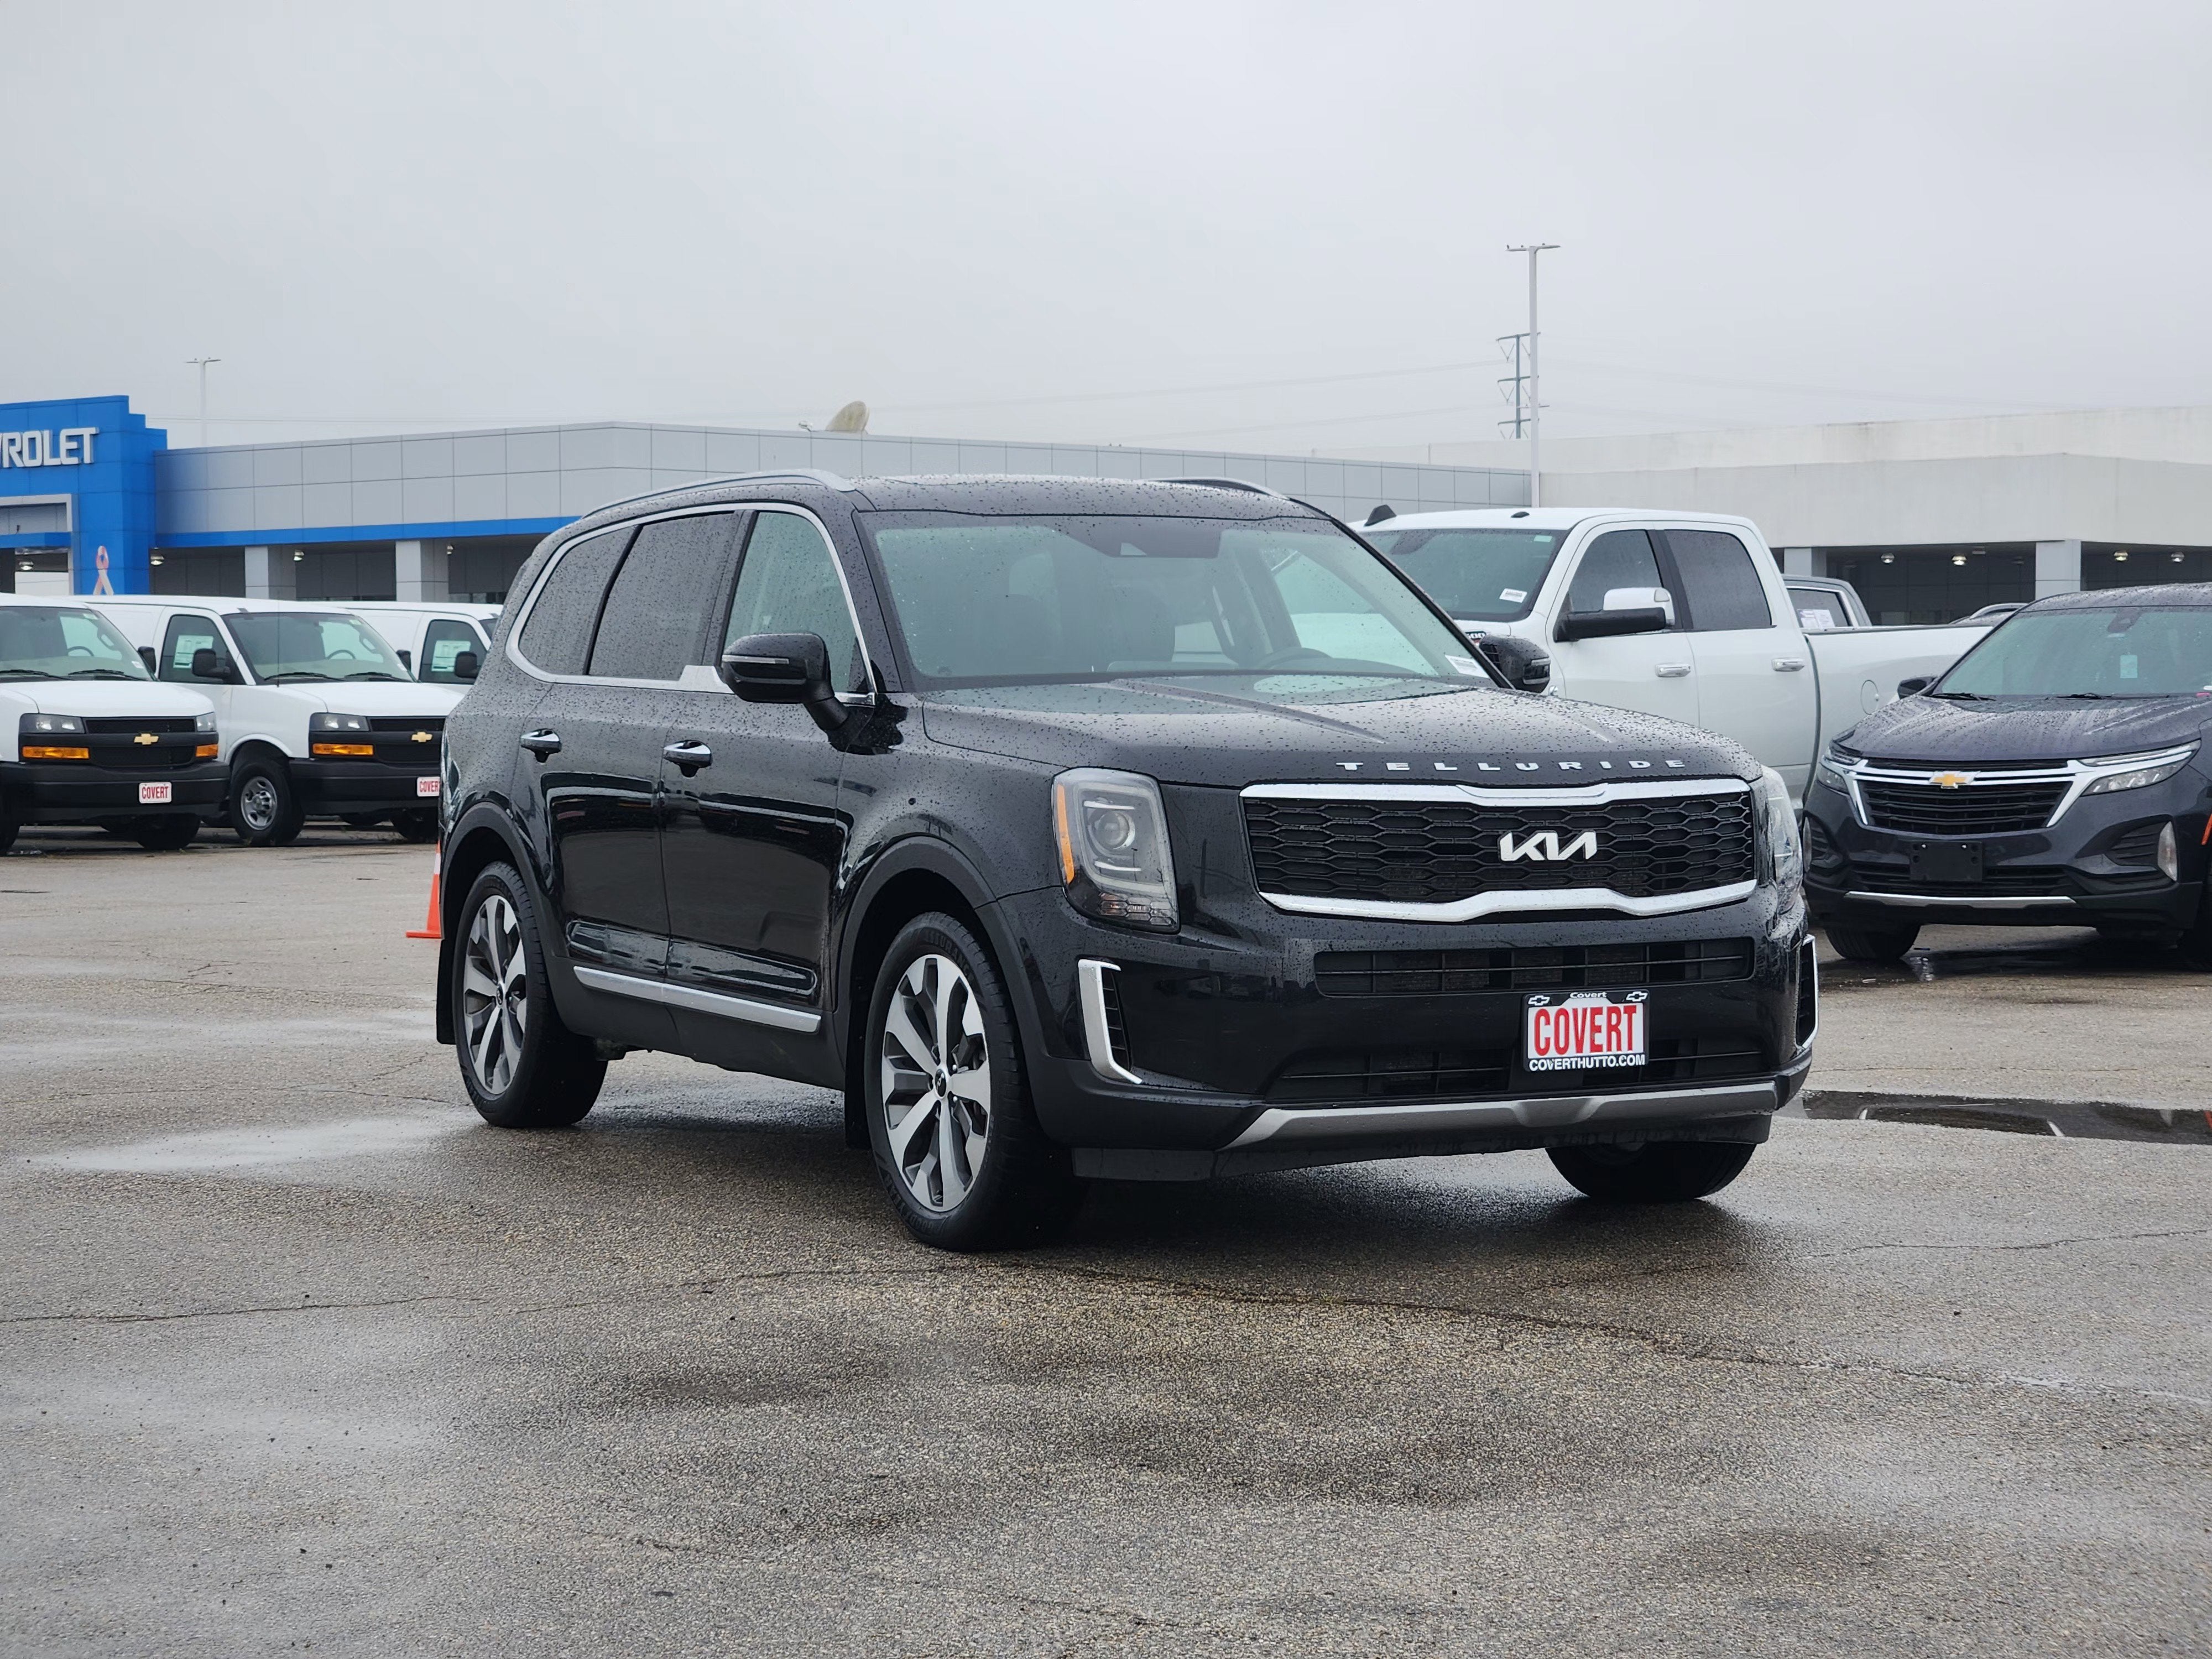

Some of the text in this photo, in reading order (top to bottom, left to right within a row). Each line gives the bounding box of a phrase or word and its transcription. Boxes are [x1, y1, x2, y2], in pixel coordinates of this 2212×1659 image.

[0, 427, 100, 468] ROLET
[1336, 760, 1686, 771] TELLURIDE
[142, 786, 169, 800] COVERT
[419, 780, 439, 792] COVER
[1499, 830, 1597, 862] KIA
[1569, 991, 1607, 999] Covert
[1533, 1005, 1637, 1056] COVERT
[1528, 1054, 1645, 1072] COVERTHUTTO.COM
